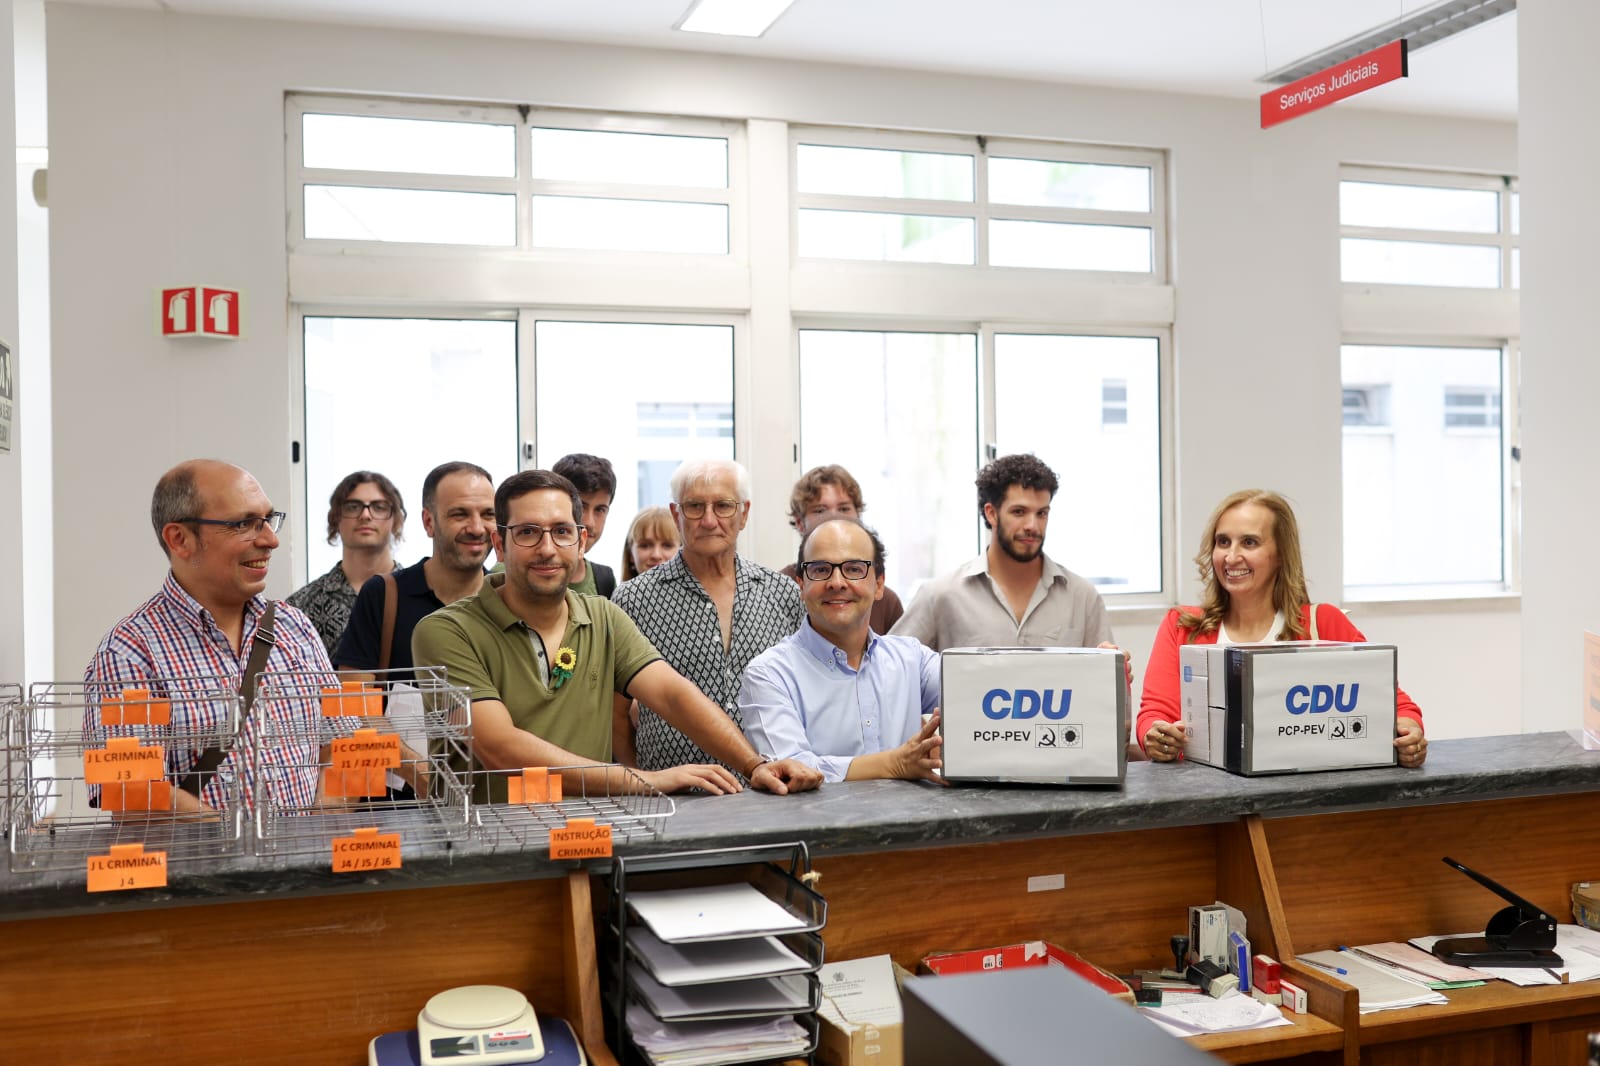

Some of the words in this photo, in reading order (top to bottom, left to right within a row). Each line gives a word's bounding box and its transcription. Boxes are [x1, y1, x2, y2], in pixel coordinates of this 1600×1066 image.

[1279, 82, 1326, 111] Serviços
[1328, 61, 1379, 92] Judiciais
[981, 688, 1073, 721] CDU
[1285, 683, 1360, 715] CDU
[973, 730, 1032, 742] PCP-PEV
[1278, 723, 1326, 737] PCP-PEV
[340, 744, 347, 752] C
[349, 740, 398, 752] CRIMINAL
[87, 754, 92, 763] J
[95, 753, 101, 763] L
[103, 750, 161, 763] CRIMINAL
[117, 771, 122, 780] J
[126, 770, 132, 779] 3
[553, 828, 611, 841] INSTRUÇÃO
[340, 843, 347, 852] C
[349, 840, 399, 852] CRIMINAL
[557, 846, 607, 858] CRIMINAL
[90, 861, 96, 871] J
[98, 861, 105, 871] L
[107, 856, 163, 869] CRIMINAL
[120, 877, 125, 887] J
[127, 877, 135, 886] 4
